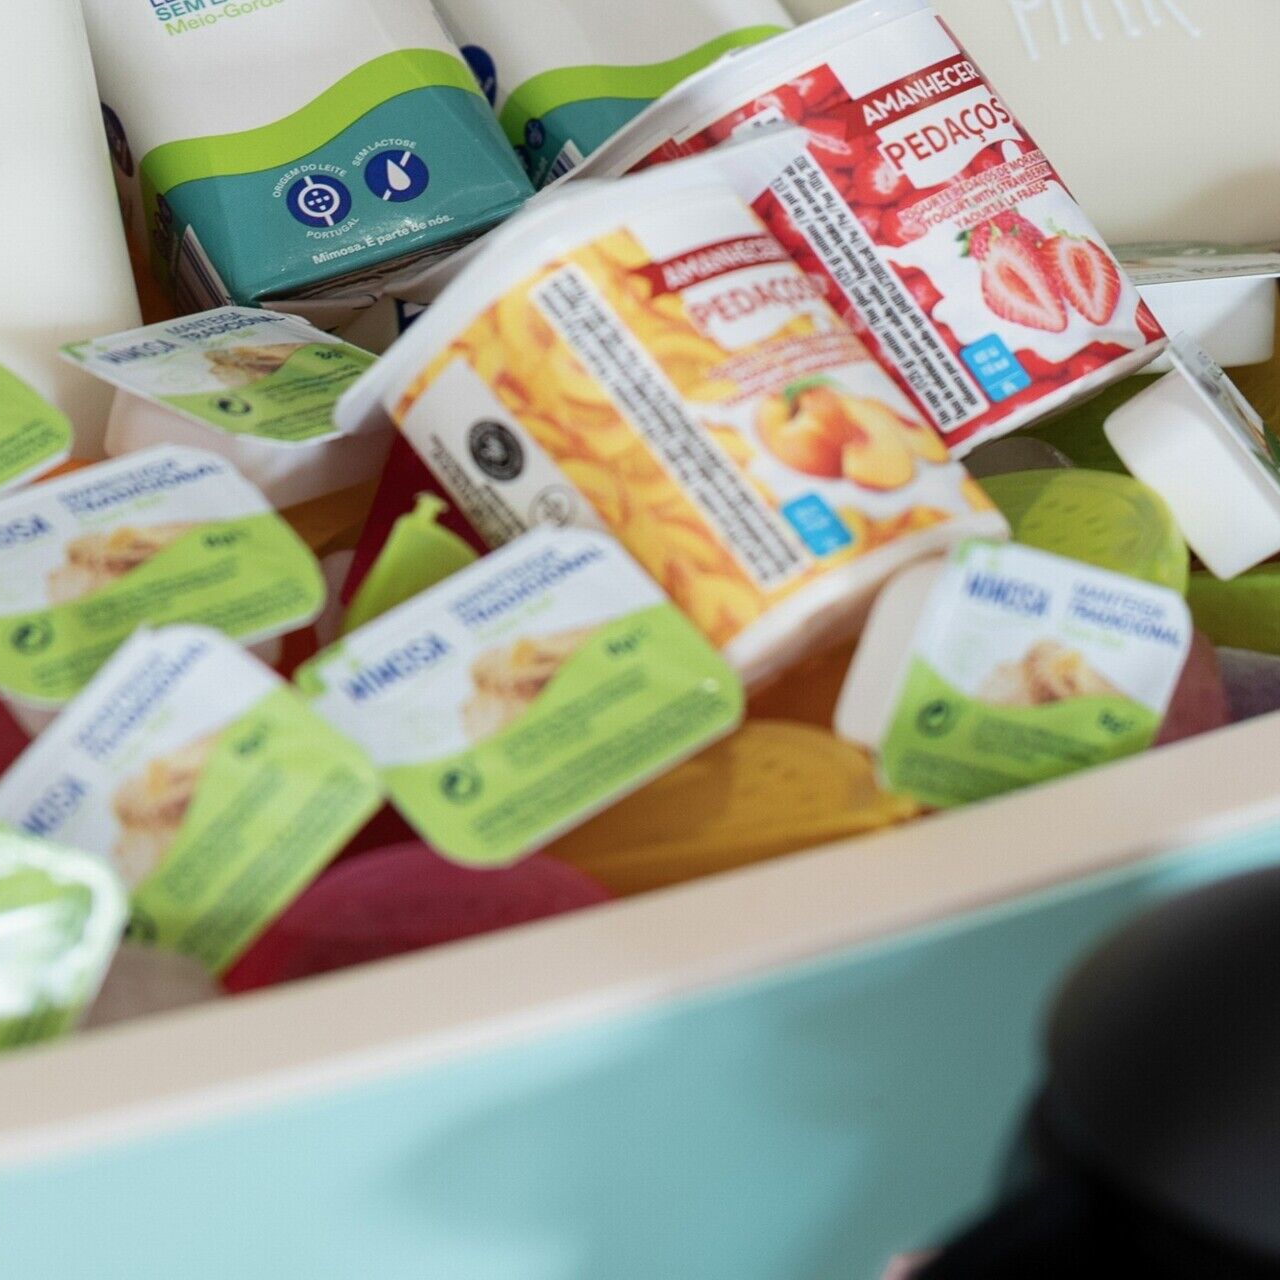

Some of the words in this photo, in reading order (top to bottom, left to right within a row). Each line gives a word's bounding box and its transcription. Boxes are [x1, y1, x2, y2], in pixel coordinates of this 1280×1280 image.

[861, 60, 981, 127] AMANHECER
[883, 94, 1013, 172] PEDAÇOS
[352, 147, 369, 167] SEM
[368, 138, 417, 151] LACTOSE
[272, 166, 299, 198] ORIGEM
[318, 164, 348, 178] LEITE
[306, 217, 360, 240] PORTUGAL
[312, 244, 366, 265] Mimosa.
[377, 228, 410, 246] parte
